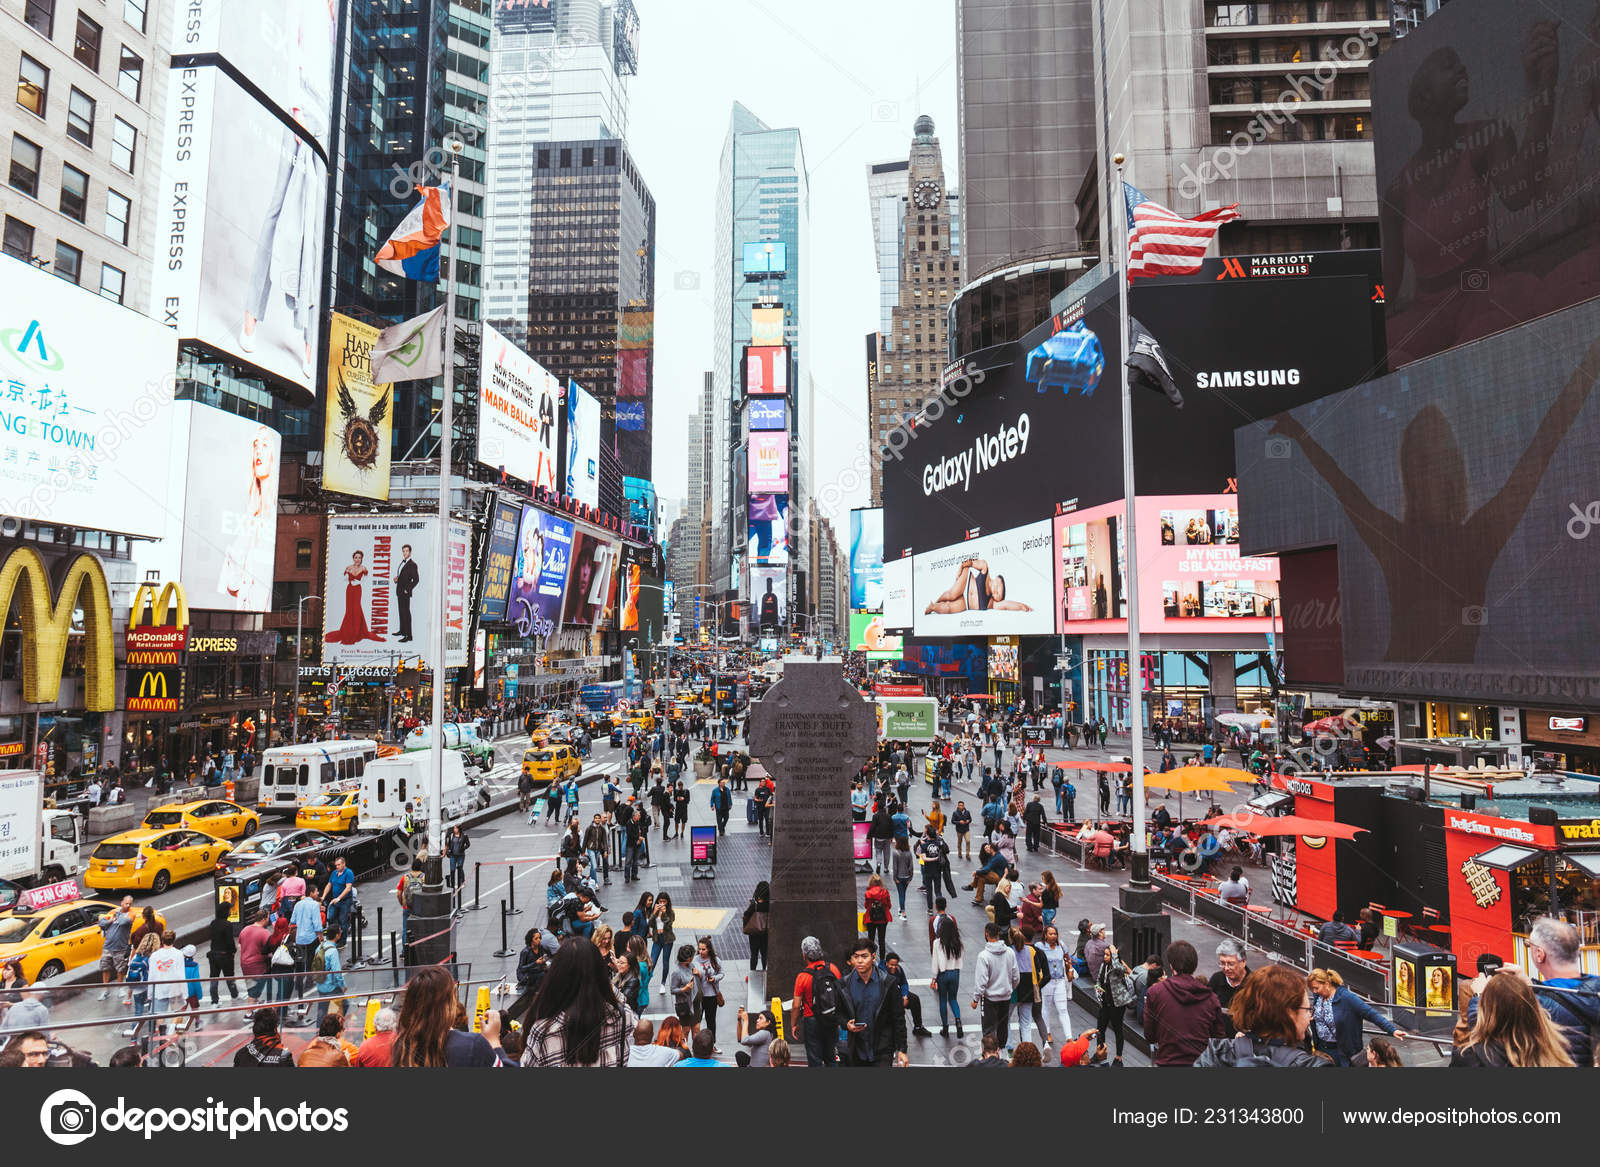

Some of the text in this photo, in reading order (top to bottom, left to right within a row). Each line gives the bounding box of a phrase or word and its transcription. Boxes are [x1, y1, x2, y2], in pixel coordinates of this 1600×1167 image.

[177, 69, 197, 162] EXPRESS
[168, 182, 188, 271] EXPRESS
[1252, 255, 1314, 265] MARRIOTT
[1252, 265, 1307, 276] MARQUIS
[1062, 296, 1086, 318] MARRIOTT
[494, 362, 533, 396] NOW STARRING
[1196, 368, 1300, 389] SAMSUNG
[492, 375, 534, 409] EMMY NOMINEE
[485, 389, 509, 412] MARK
[510, 404, 538, 433] BALLAS
[923, 412, 1030, 496] Galaxy Note9
[574, 498, 640, 541] BROADWAY
[373, 536, 391, 578] PRETTY
[1179, 559, 1273, 572] IS BLAZING-FAST
[1186, 549, 1240, 560] MY NETW
[450, 542, 465, 630] PRETTY
[371, 587, 389, 634] WOMAN
[516, 597, 554, 650] Disney
[127, 633, 184, 641] McDonald's
[189, 637, 237, 652] EXPRESS
[298, 667, 330, 676] GIFTS
[776, 720, 810, 729] FRANCIS
[823, 720, 853, 729] DUFFY
[897, 710, 924, 719] Peapod
[1450, 817, 1491, 834] belgian
[1493, 827, 1534, 842] waffles
[31, 882, 78, 905] MEAN GIRLS
